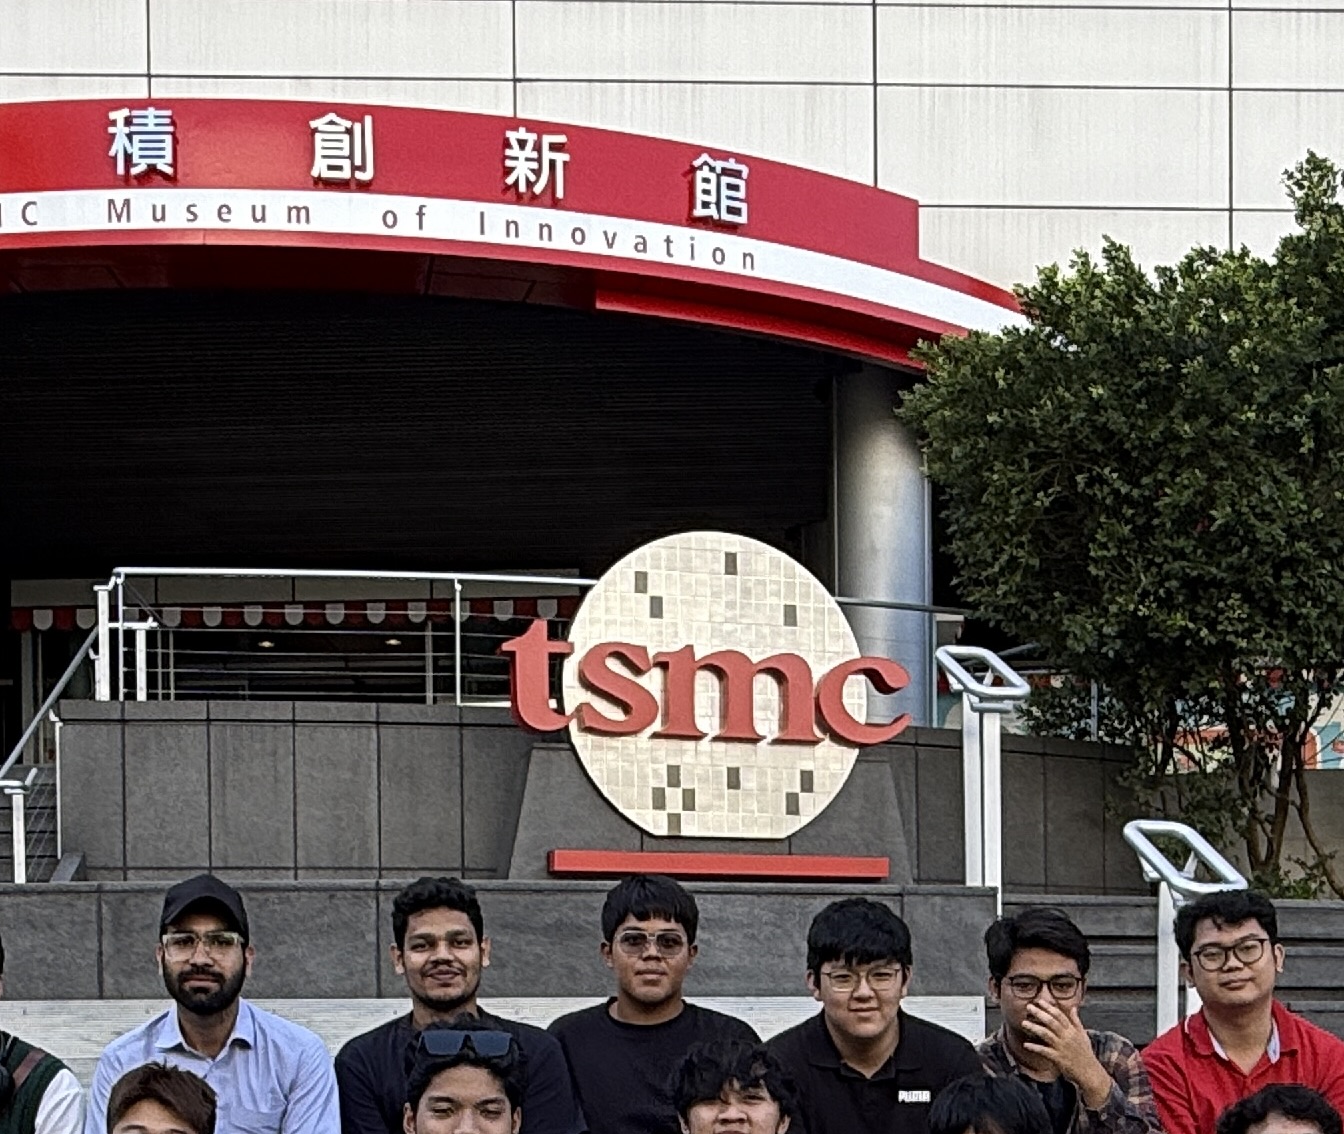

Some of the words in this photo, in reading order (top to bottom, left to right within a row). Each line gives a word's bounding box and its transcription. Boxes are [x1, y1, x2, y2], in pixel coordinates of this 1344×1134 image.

[107, 198, 311, 225] Museum
[382, 205, 427, 231] of
[479, 210, 755, 271] Innovation
[500, 618, 911, 746] tsmc
